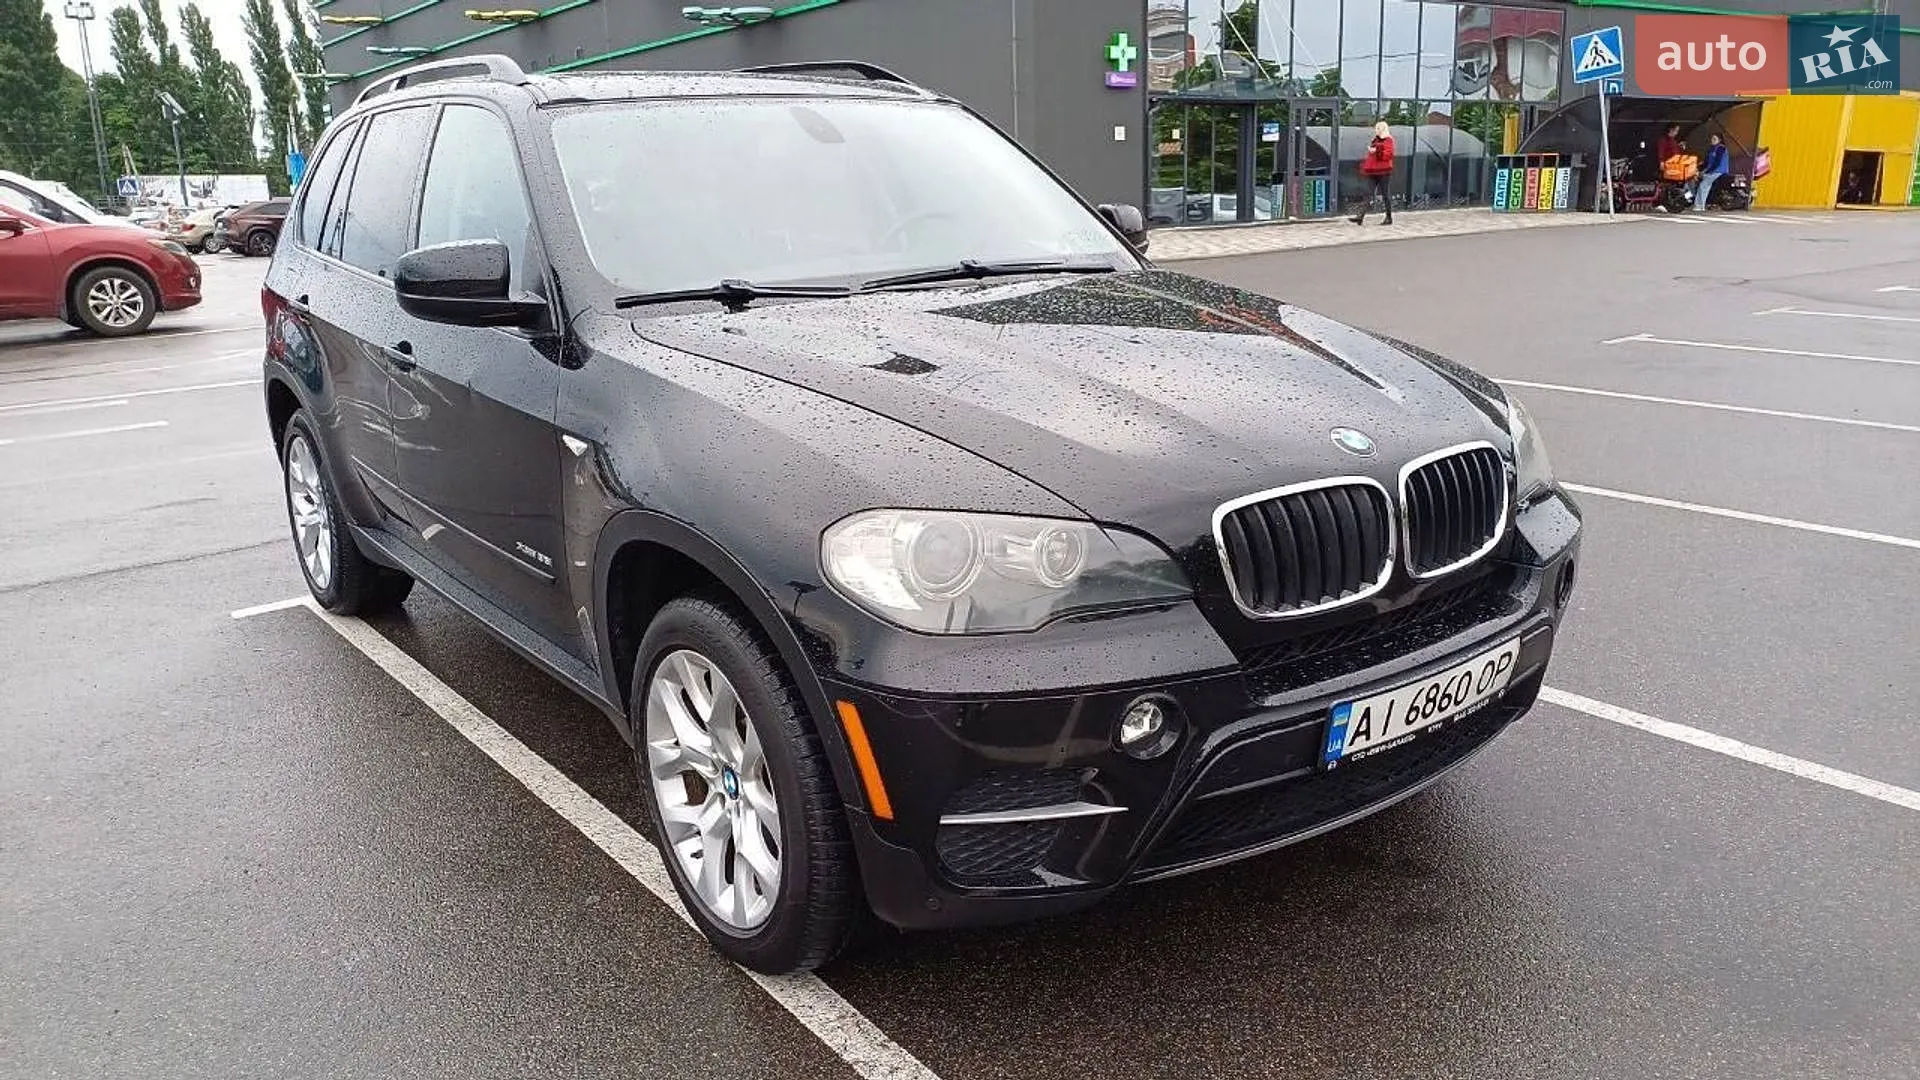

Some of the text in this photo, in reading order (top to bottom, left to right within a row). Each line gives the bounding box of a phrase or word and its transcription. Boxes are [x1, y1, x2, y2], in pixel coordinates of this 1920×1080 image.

[1495, 171, 1507, 207] ПАПІР
[1510, 170, 1522, 207] СКЛО
[1527, 169, 1538, 207] МЕТАЛ
[1348, 699, 1395, 747] AI
[1405, 670, 1471, 726] 6860
[1476, 651, 1512, 695] OP
[1327, 739, 1342, 753] UA
